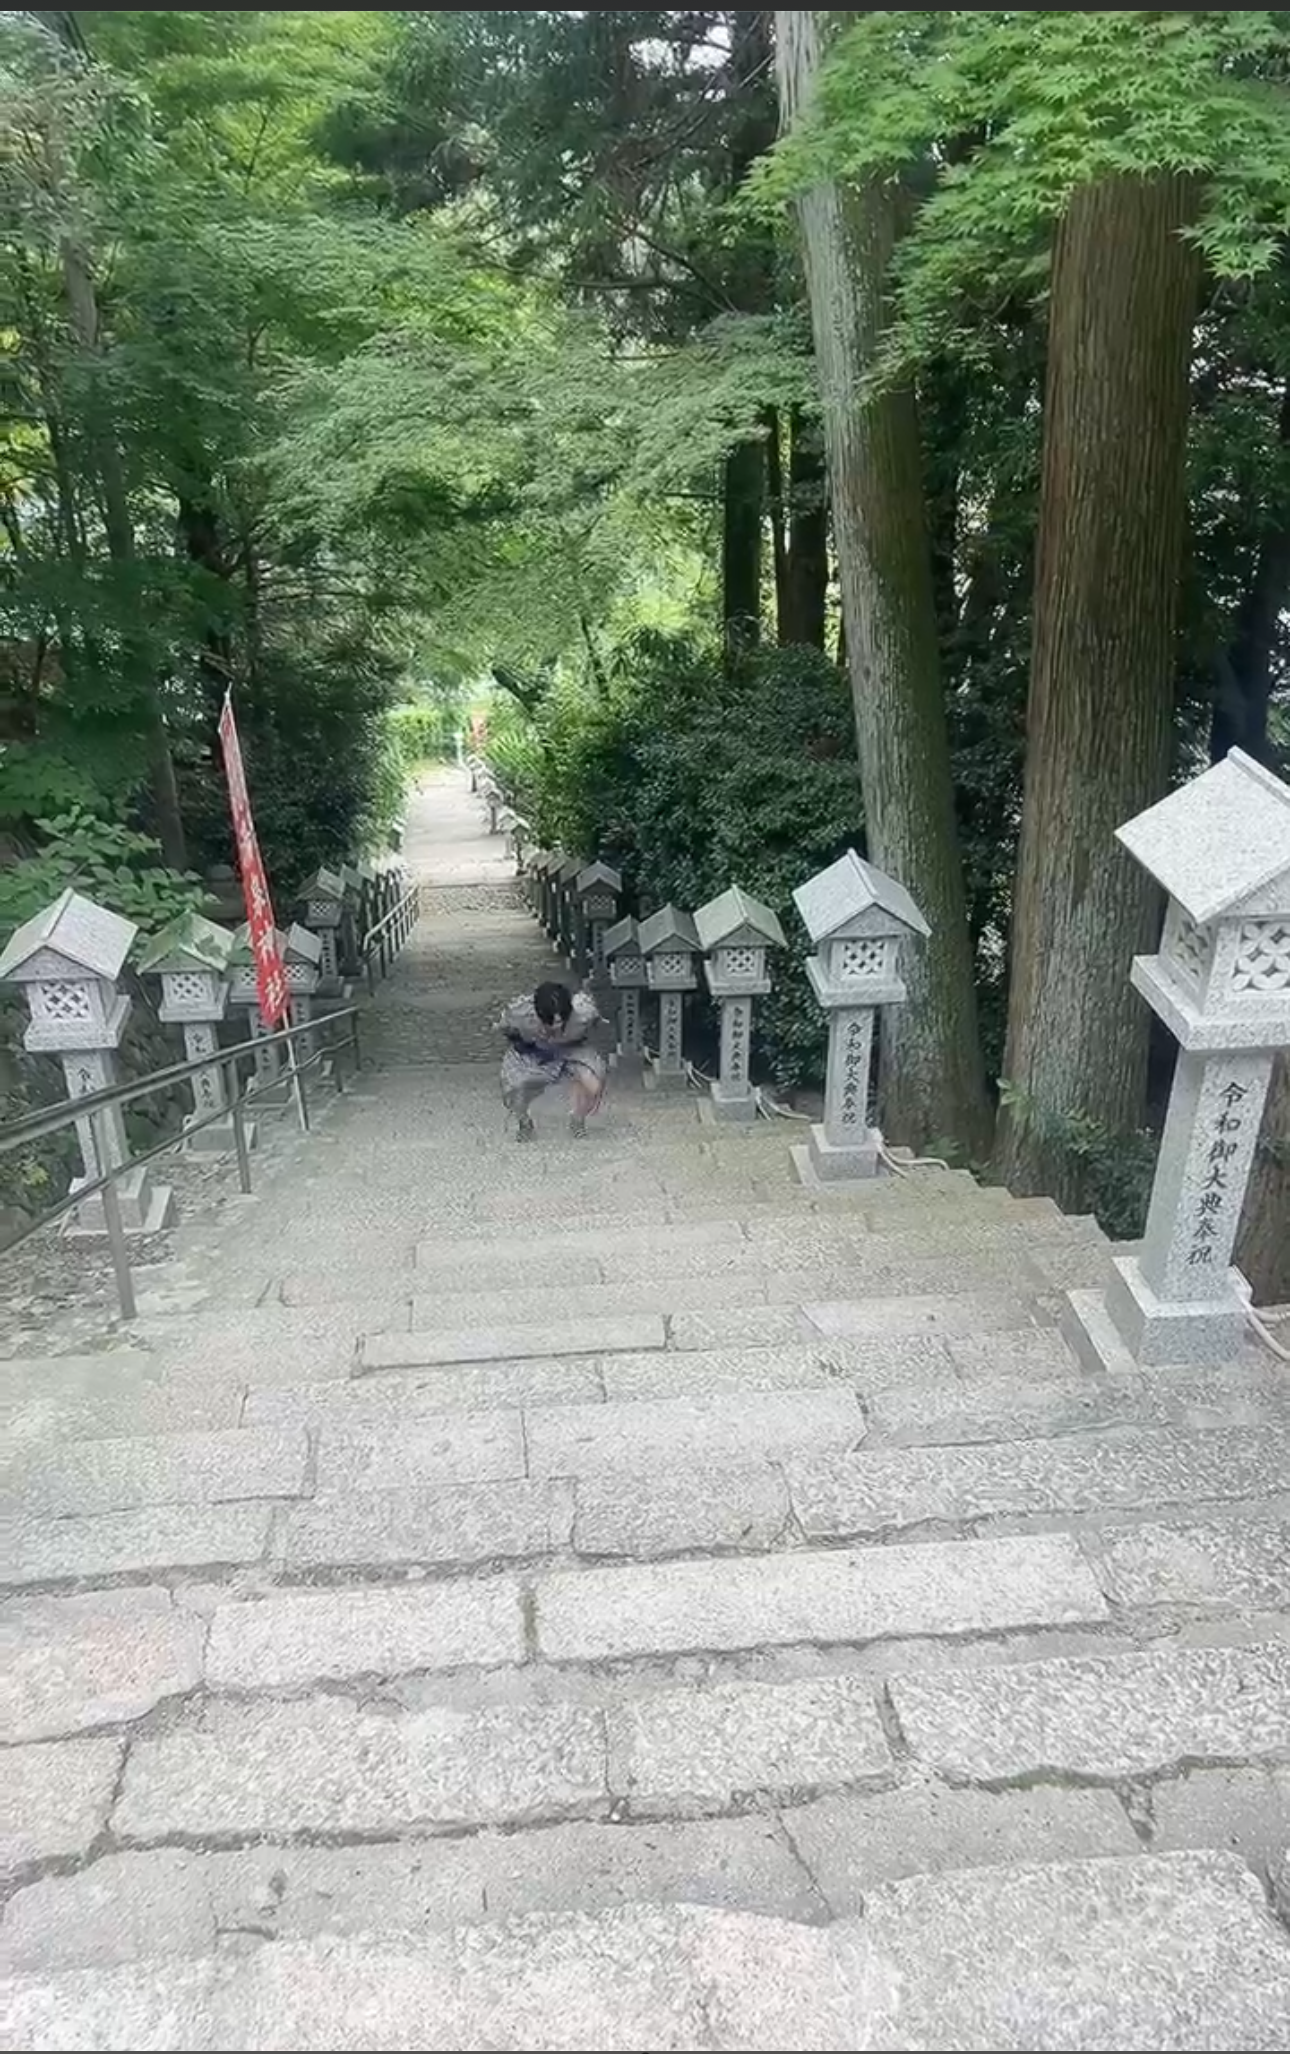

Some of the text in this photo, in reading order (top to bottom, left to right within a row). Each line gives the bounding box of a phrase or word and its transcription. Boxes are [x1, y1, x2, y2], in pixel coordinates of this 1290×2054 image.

[1187, 1081, 1248, 1265] 令和御大典奉祝
